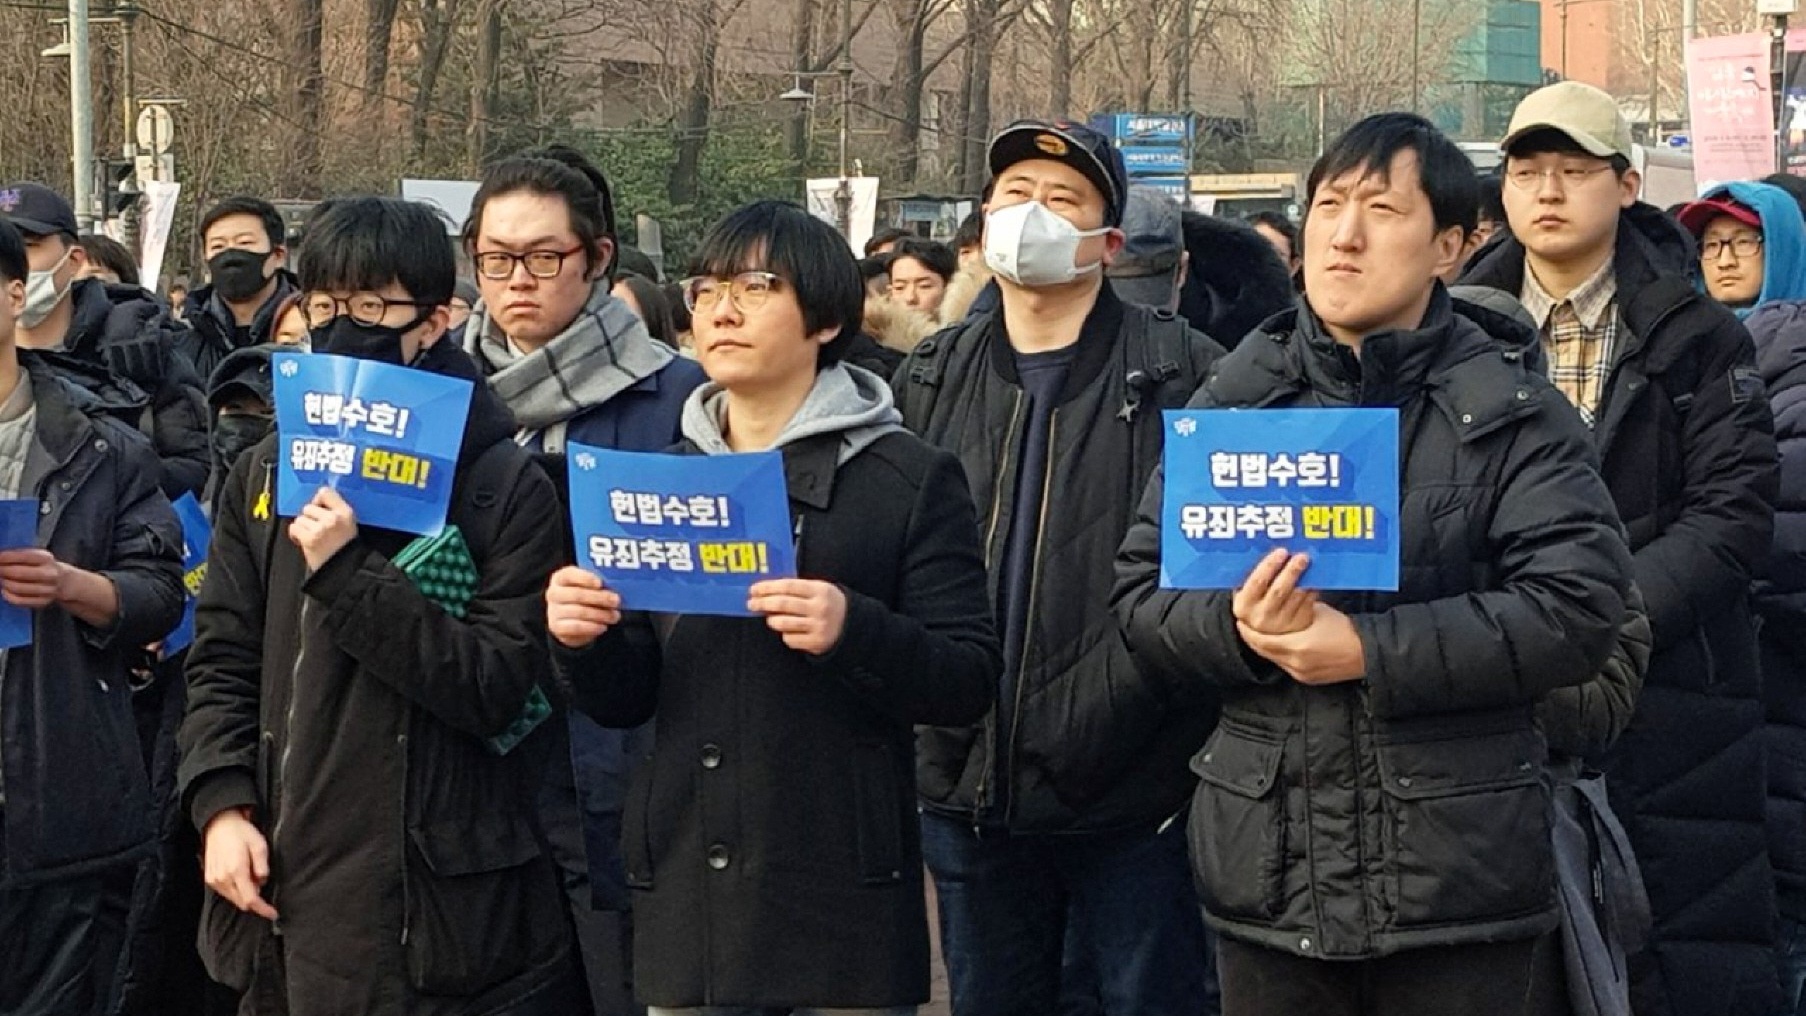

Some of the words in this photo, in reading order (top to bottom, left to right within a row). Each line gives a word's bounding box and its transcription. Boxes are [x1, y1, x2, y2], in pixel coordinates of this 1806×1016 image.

[303, 392, 410, 439] 헌법수호!
[290, 438, 356, 475] 유죄추정
[362, 447, 431, 489] 반대!
[1210, 451, 1340, 488] 헌법수호!
[609, 489, 731, 528] 헌법수호!
[1180, 505, 1295, 539] 유죄추정
[1302, 505, 1375, 540] 반대!
[589, 536, 694, 572] 유죄추정
[698, 542, 769, 574] 반대!
